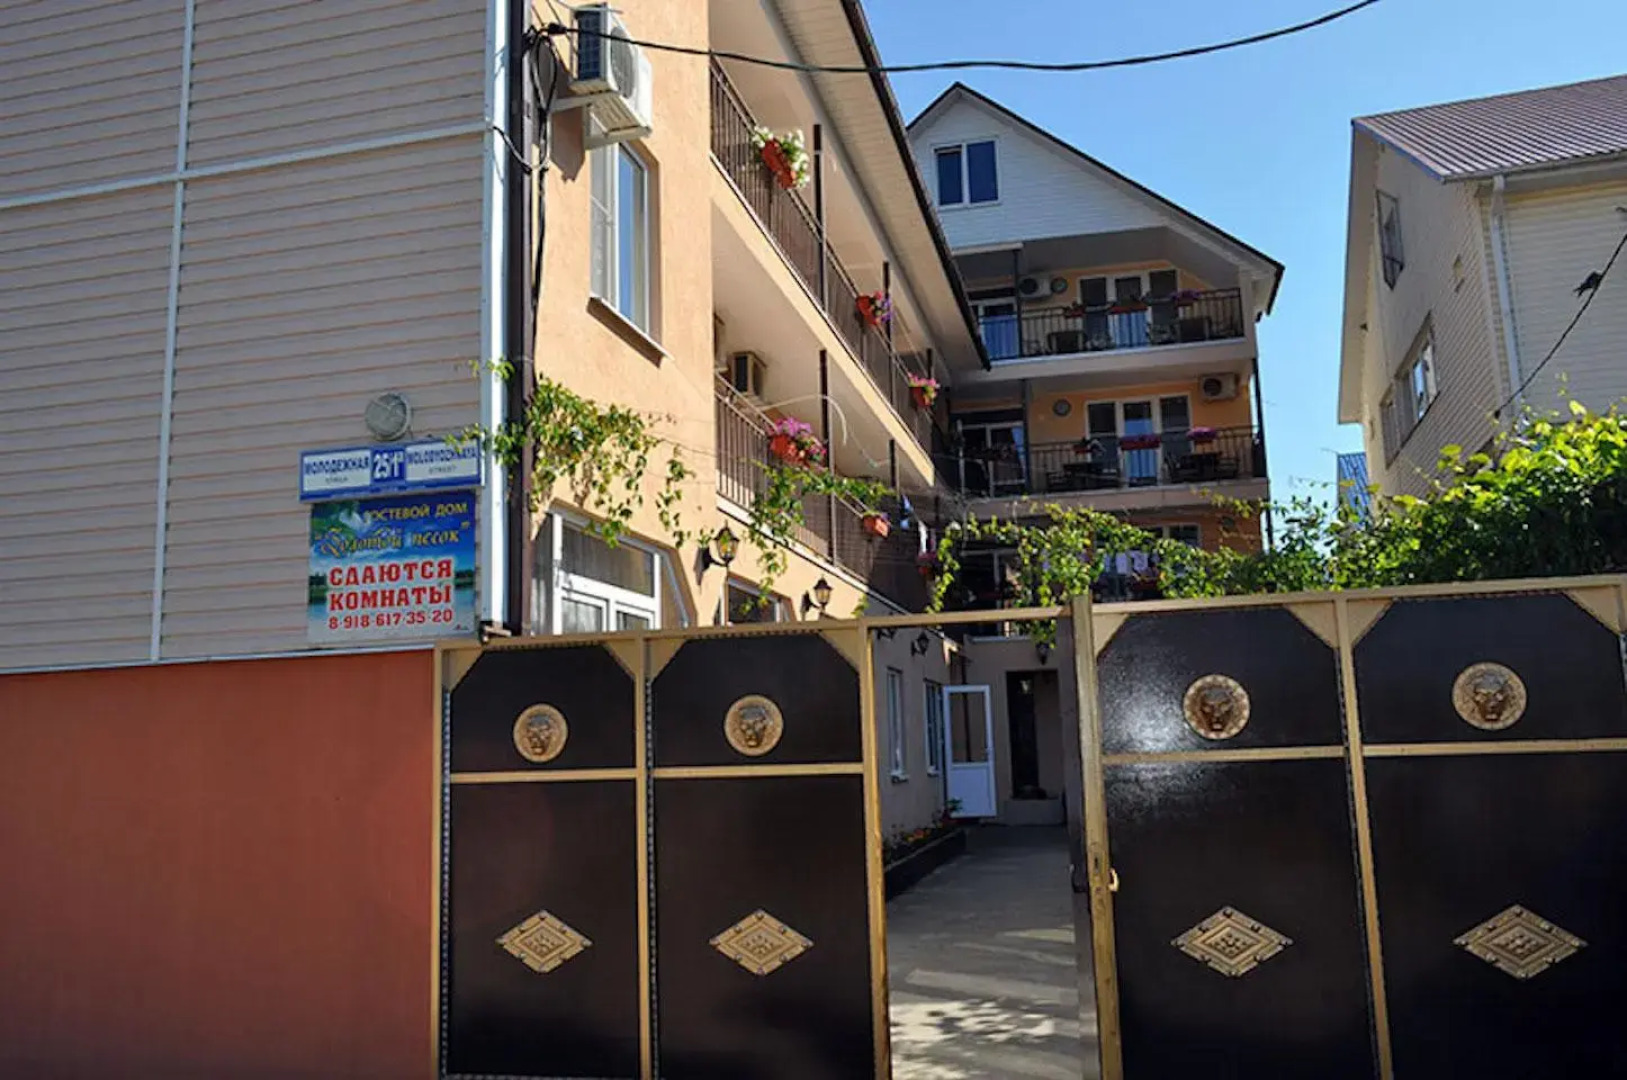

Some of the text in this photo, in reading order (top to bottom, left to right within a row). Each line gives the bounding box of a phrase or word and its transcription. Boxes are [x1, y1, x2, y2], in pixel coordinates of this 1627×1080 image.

[435, 503, 469, 518] ДОМ
[329, 559, 453, 586] СДАЮТСЯ
[329, 584, 452, 612] КОМНАТЫ
